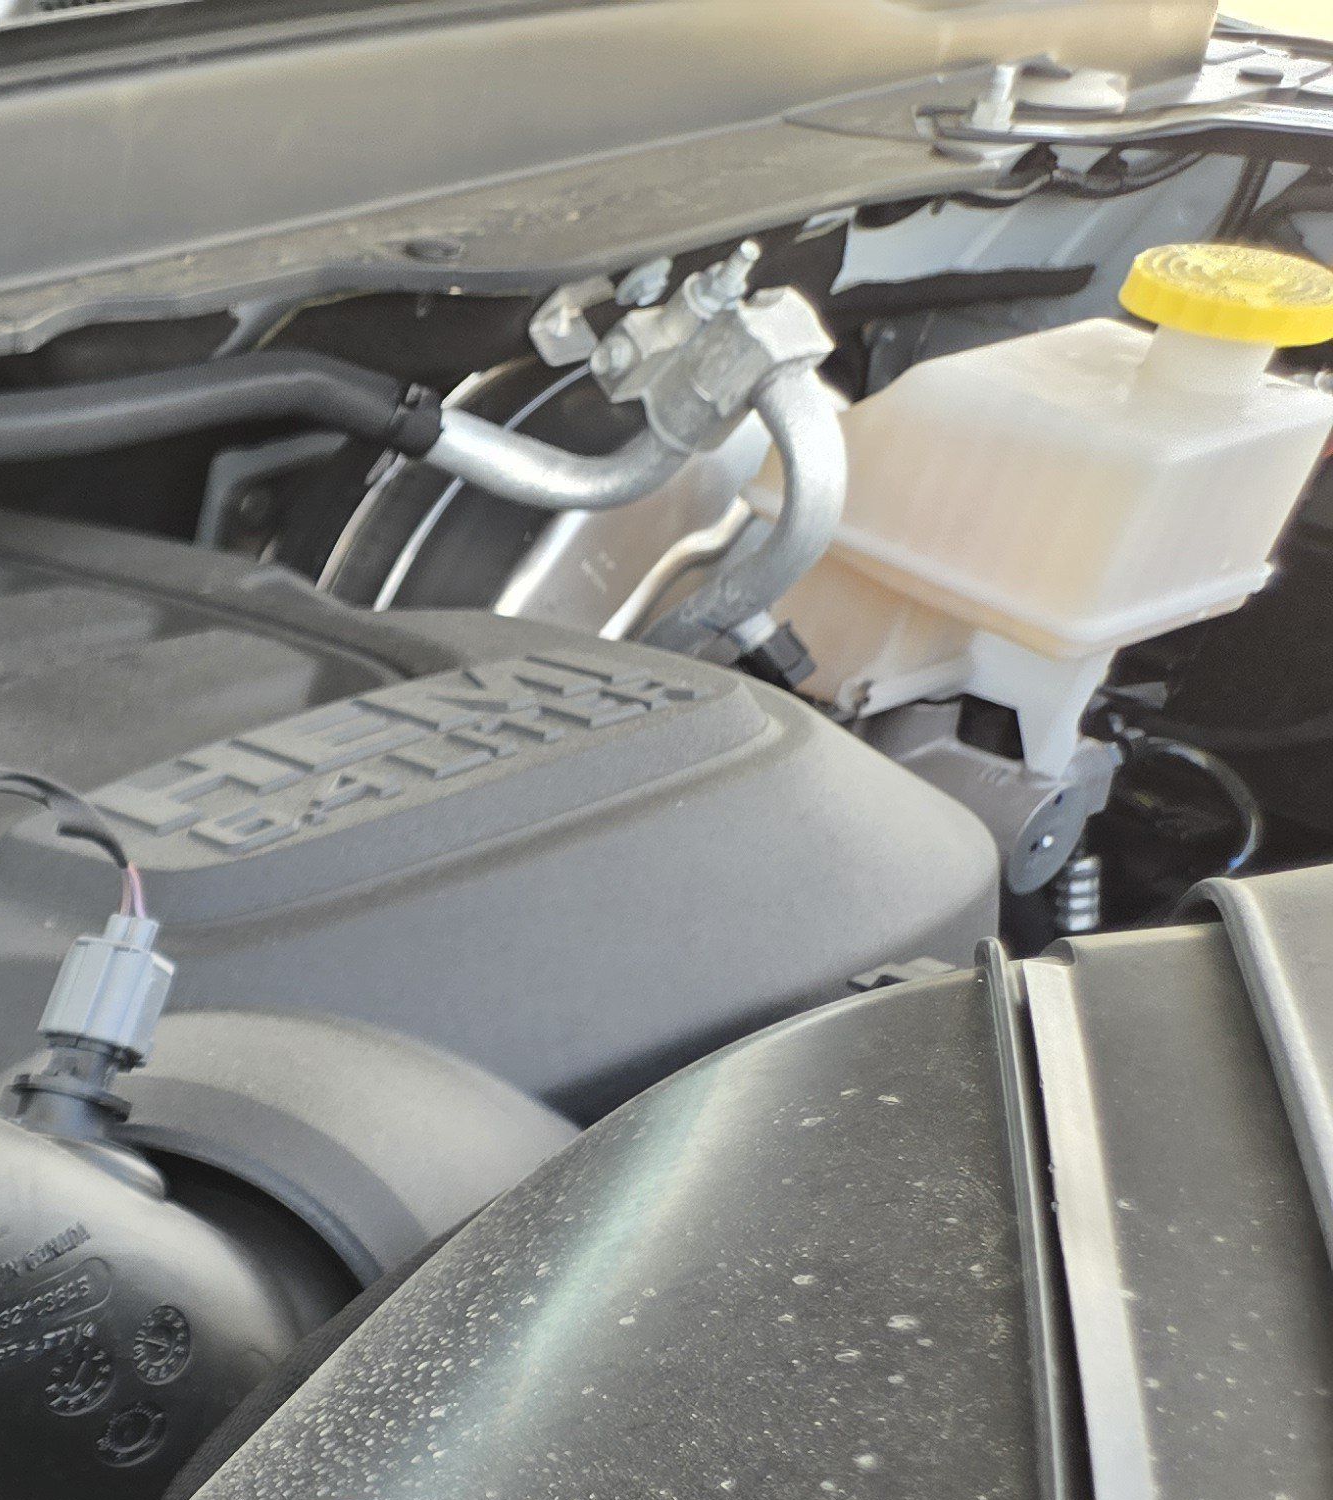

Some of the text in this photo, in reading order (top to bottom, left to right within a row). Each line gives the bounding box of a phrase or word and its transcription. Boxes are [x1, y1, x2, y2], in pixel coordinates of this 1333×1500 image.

[86, 652, 653, 836] HEMI
[187, 676, 719, 856] 6.4 LITER
